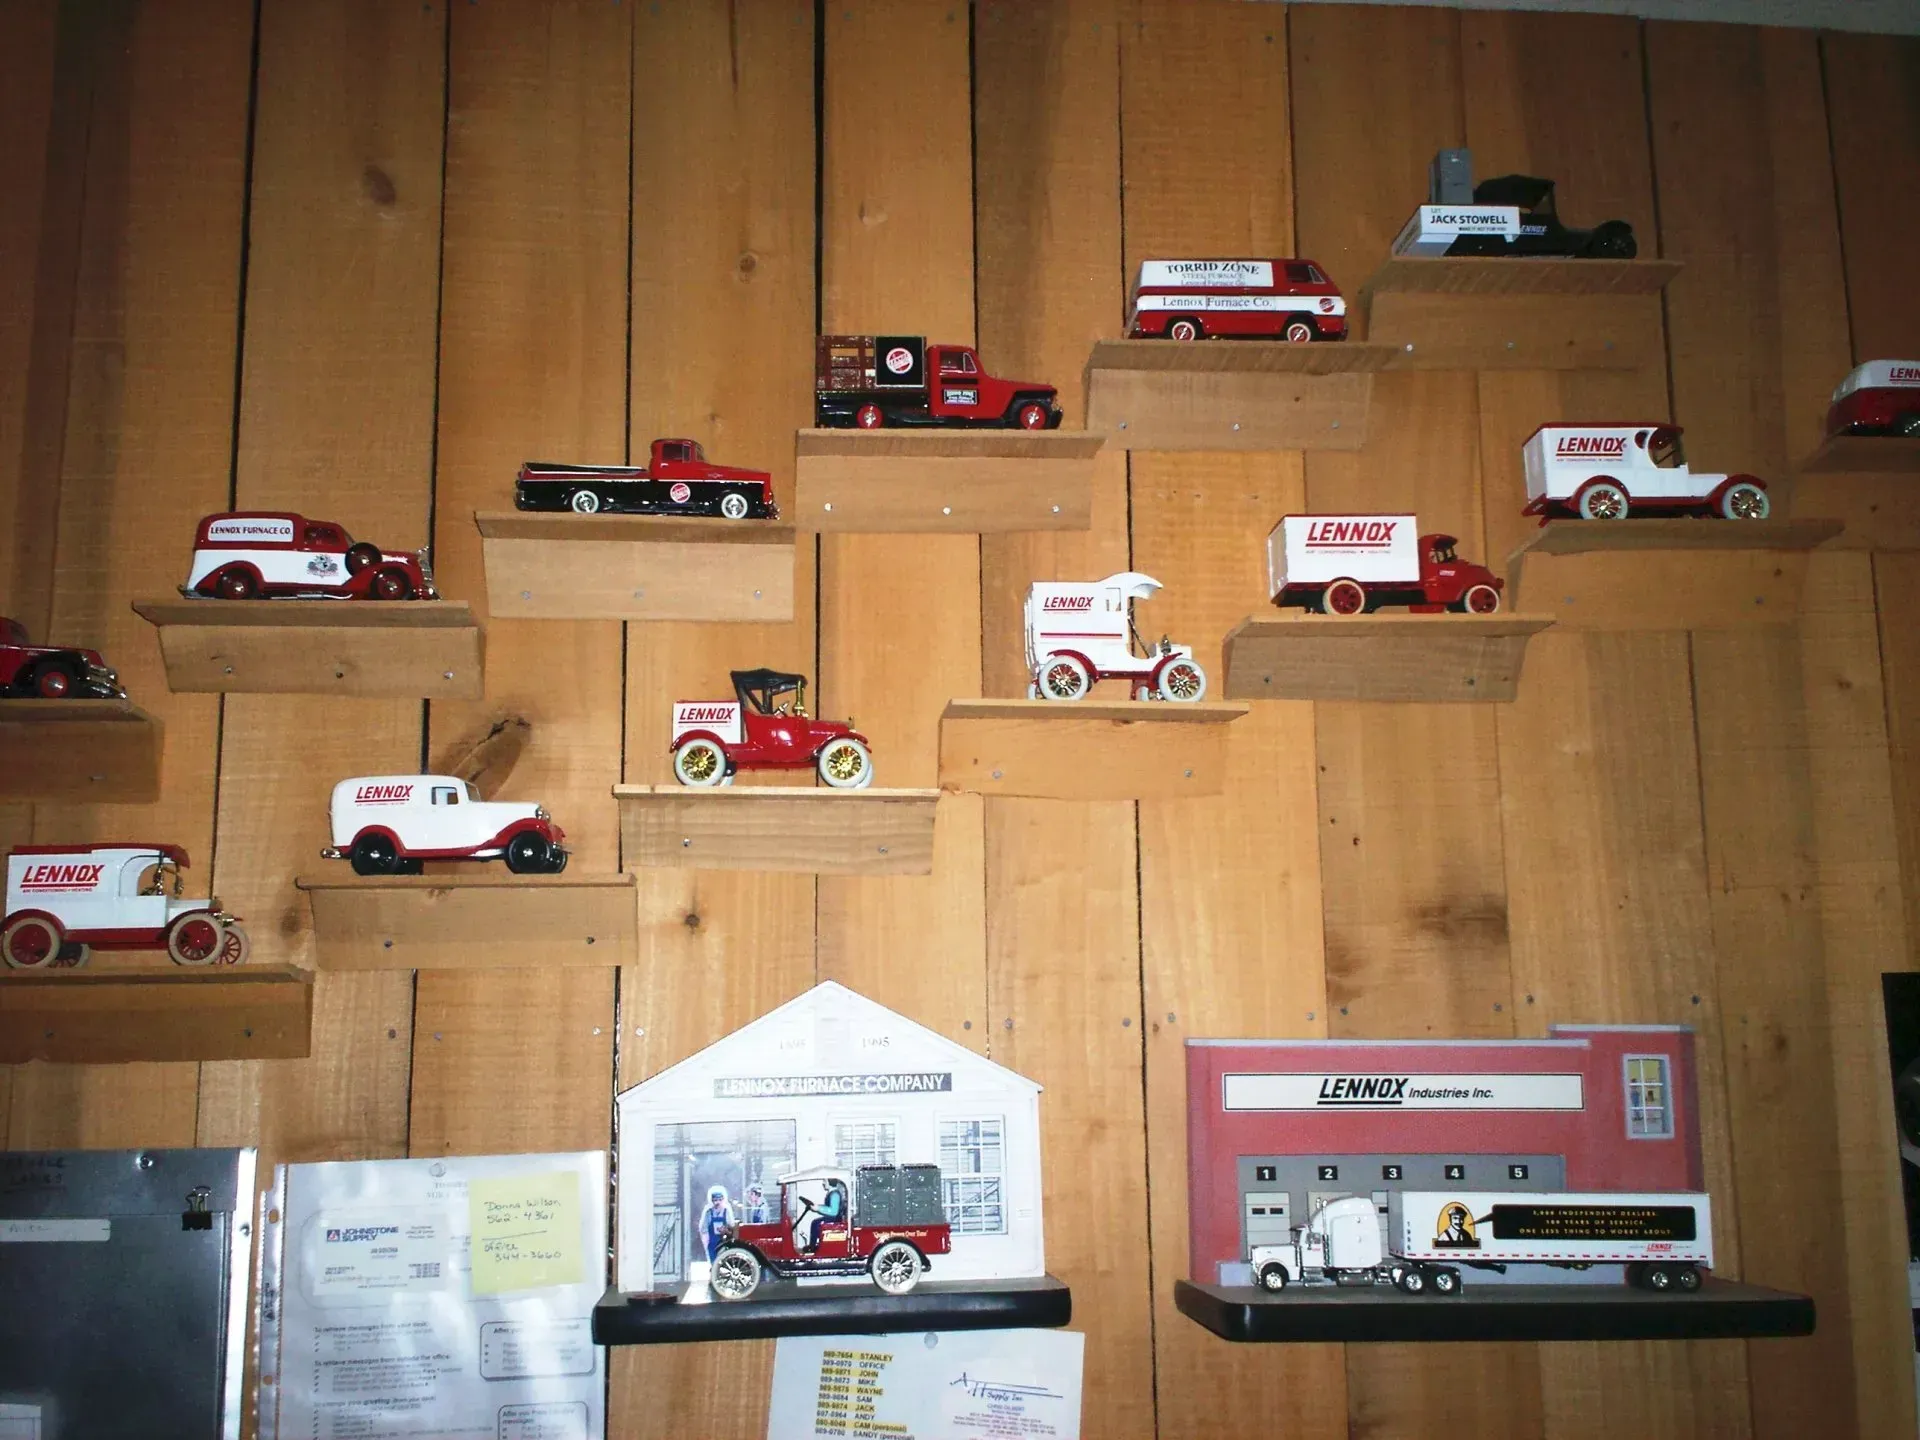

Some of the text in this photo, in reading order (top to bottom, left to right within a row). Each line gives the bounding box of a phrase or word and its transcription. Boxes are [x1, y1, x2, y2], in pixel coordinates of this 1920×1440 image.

[1430, 215, 1508, 224] JACK STOWELL
[1166, 262, 1260, 275] TORRID ZONE
[1162, 296, 1273, 308] Lennox Furnace Co.
[1557, 437, 1628, 452] LENNOX
[211, 526, 241, 534] LENNOX
[243, 526, 278, 535] FURNACE
[1307, 522, 1397, 541] LENNOX
[1043, 596, 1094, 608] LENNOX
[679, 707, 735, 720] LENNOX
[356, 785, 414, 799] LENNOX
[22, 864, 105, 883] LENNOX
[723, 1074, 945, 1096] LENNOX FURNACE COMPANY
[1319, 1078, 1494, 1099] LENNOX Industries Inc.
[342, 1226, 399, 1236] JOHNSTONE
[1646, 1243, 1673, 1251] LENNOX
[860, 1352, 893, 1362] STANLEY
[859, 1361, 885, 1370] OFFICE
[856, 1387, 884, 1395] WAYNE
[987, 1390, 1010, 1402] Supply
[856, 1395, 873, 1403] SAM
[854, 1404, 875, 1412] JACK
[854, 1412, 875, 1420] ANDY
[853, 1421, 871, 1429] CAM
[852, 1430, 878, 1438] SANDY
